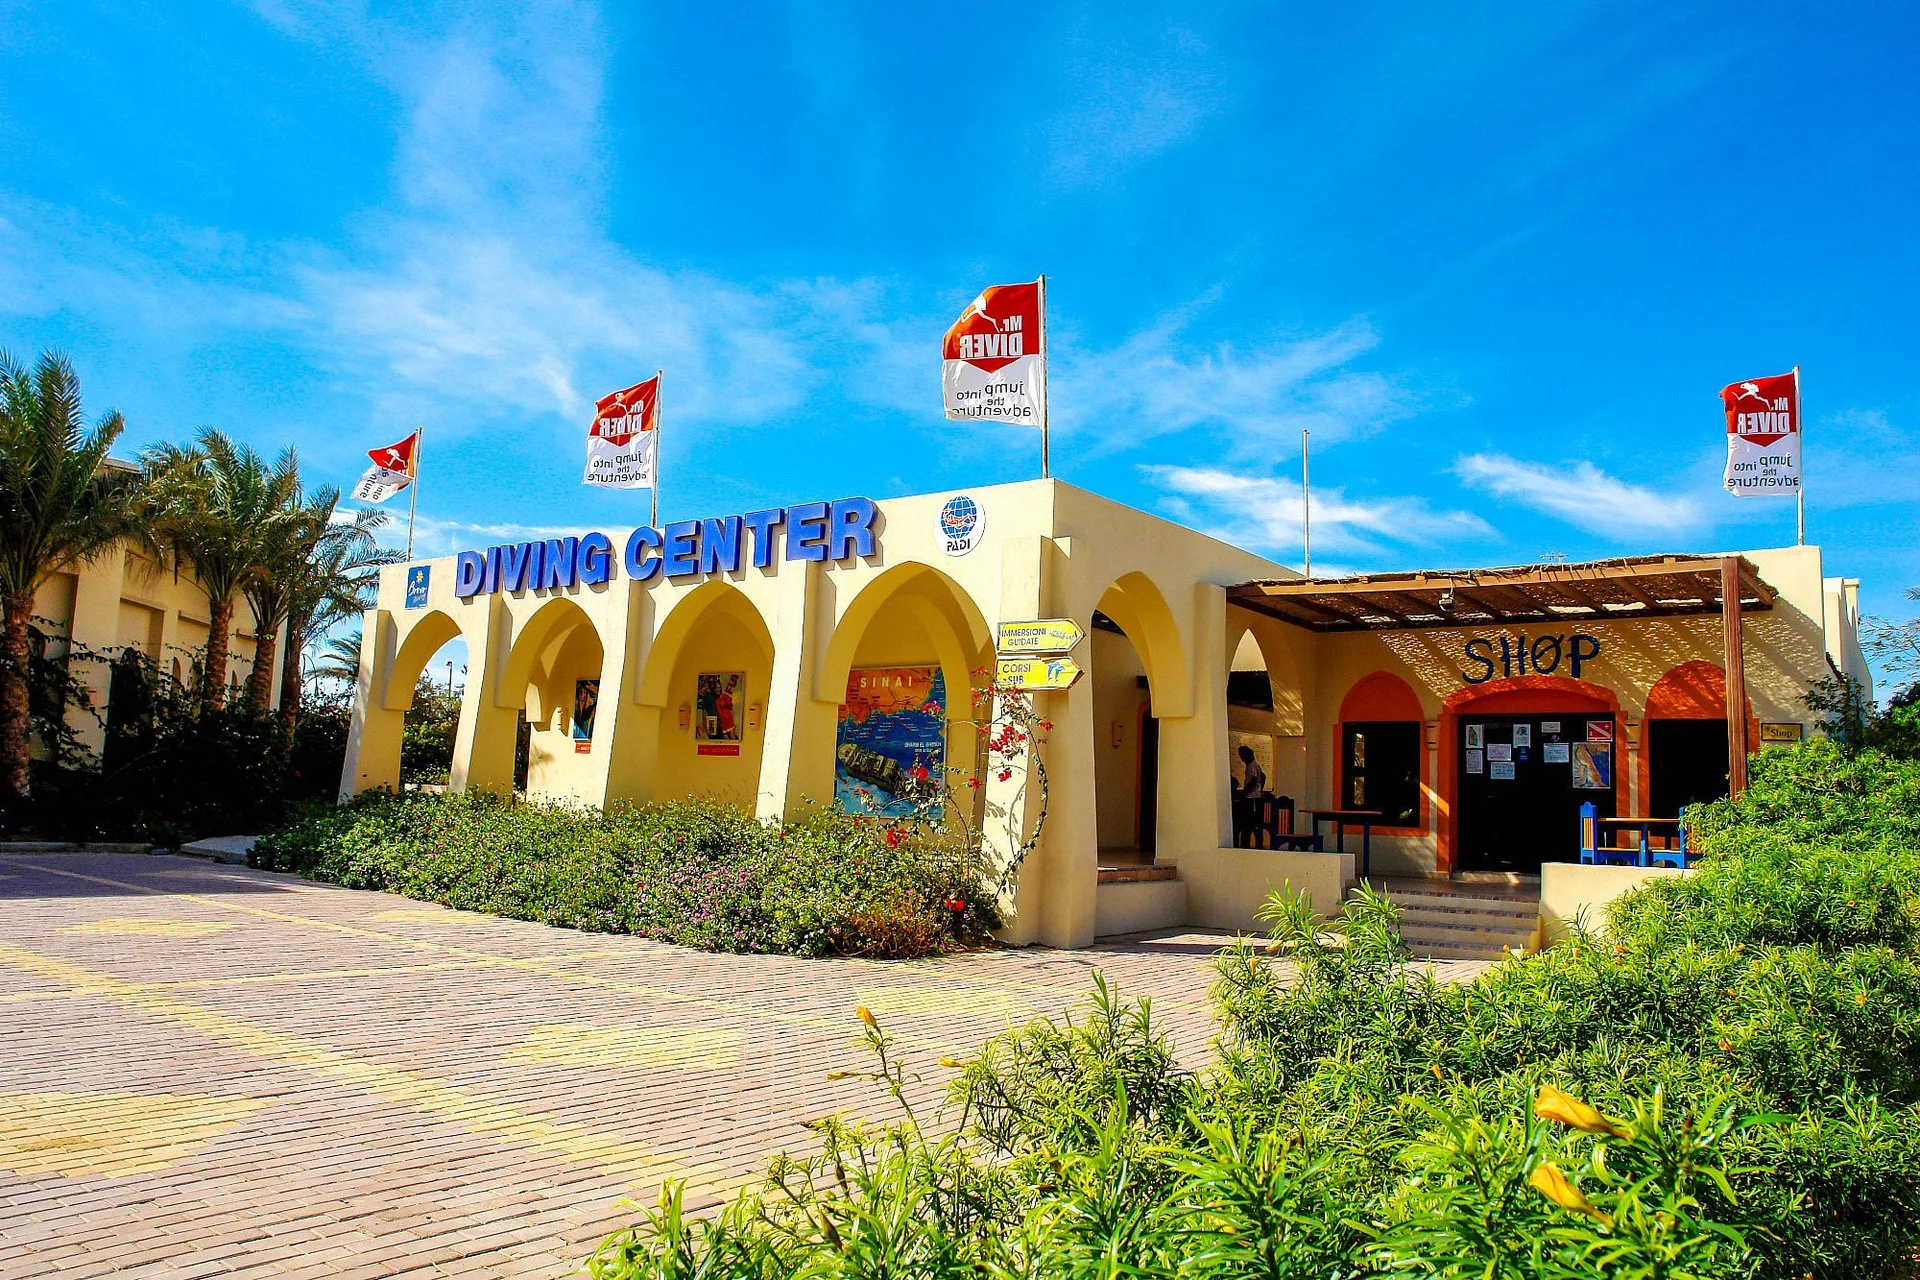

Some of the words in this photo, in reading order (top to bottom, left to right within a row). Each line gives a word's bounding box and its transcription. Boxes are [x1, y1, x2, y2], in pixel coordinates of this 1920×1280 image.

[455, 532, 611, 598] DIVING
[625, 496, 878, 581] CENTER
[946, 538, 970, 552] PADI
[1001, 627, 1047, 638] IMMERSIONI
[1007, 637, 1039, 647] GUIDATE
[1002, 663, 1031, 674] CORSI
[860, 675, 913, 689] SINAI
[1008, 675, 1024, 685] SUB
[1770, 728, 1793, 738] Shop
